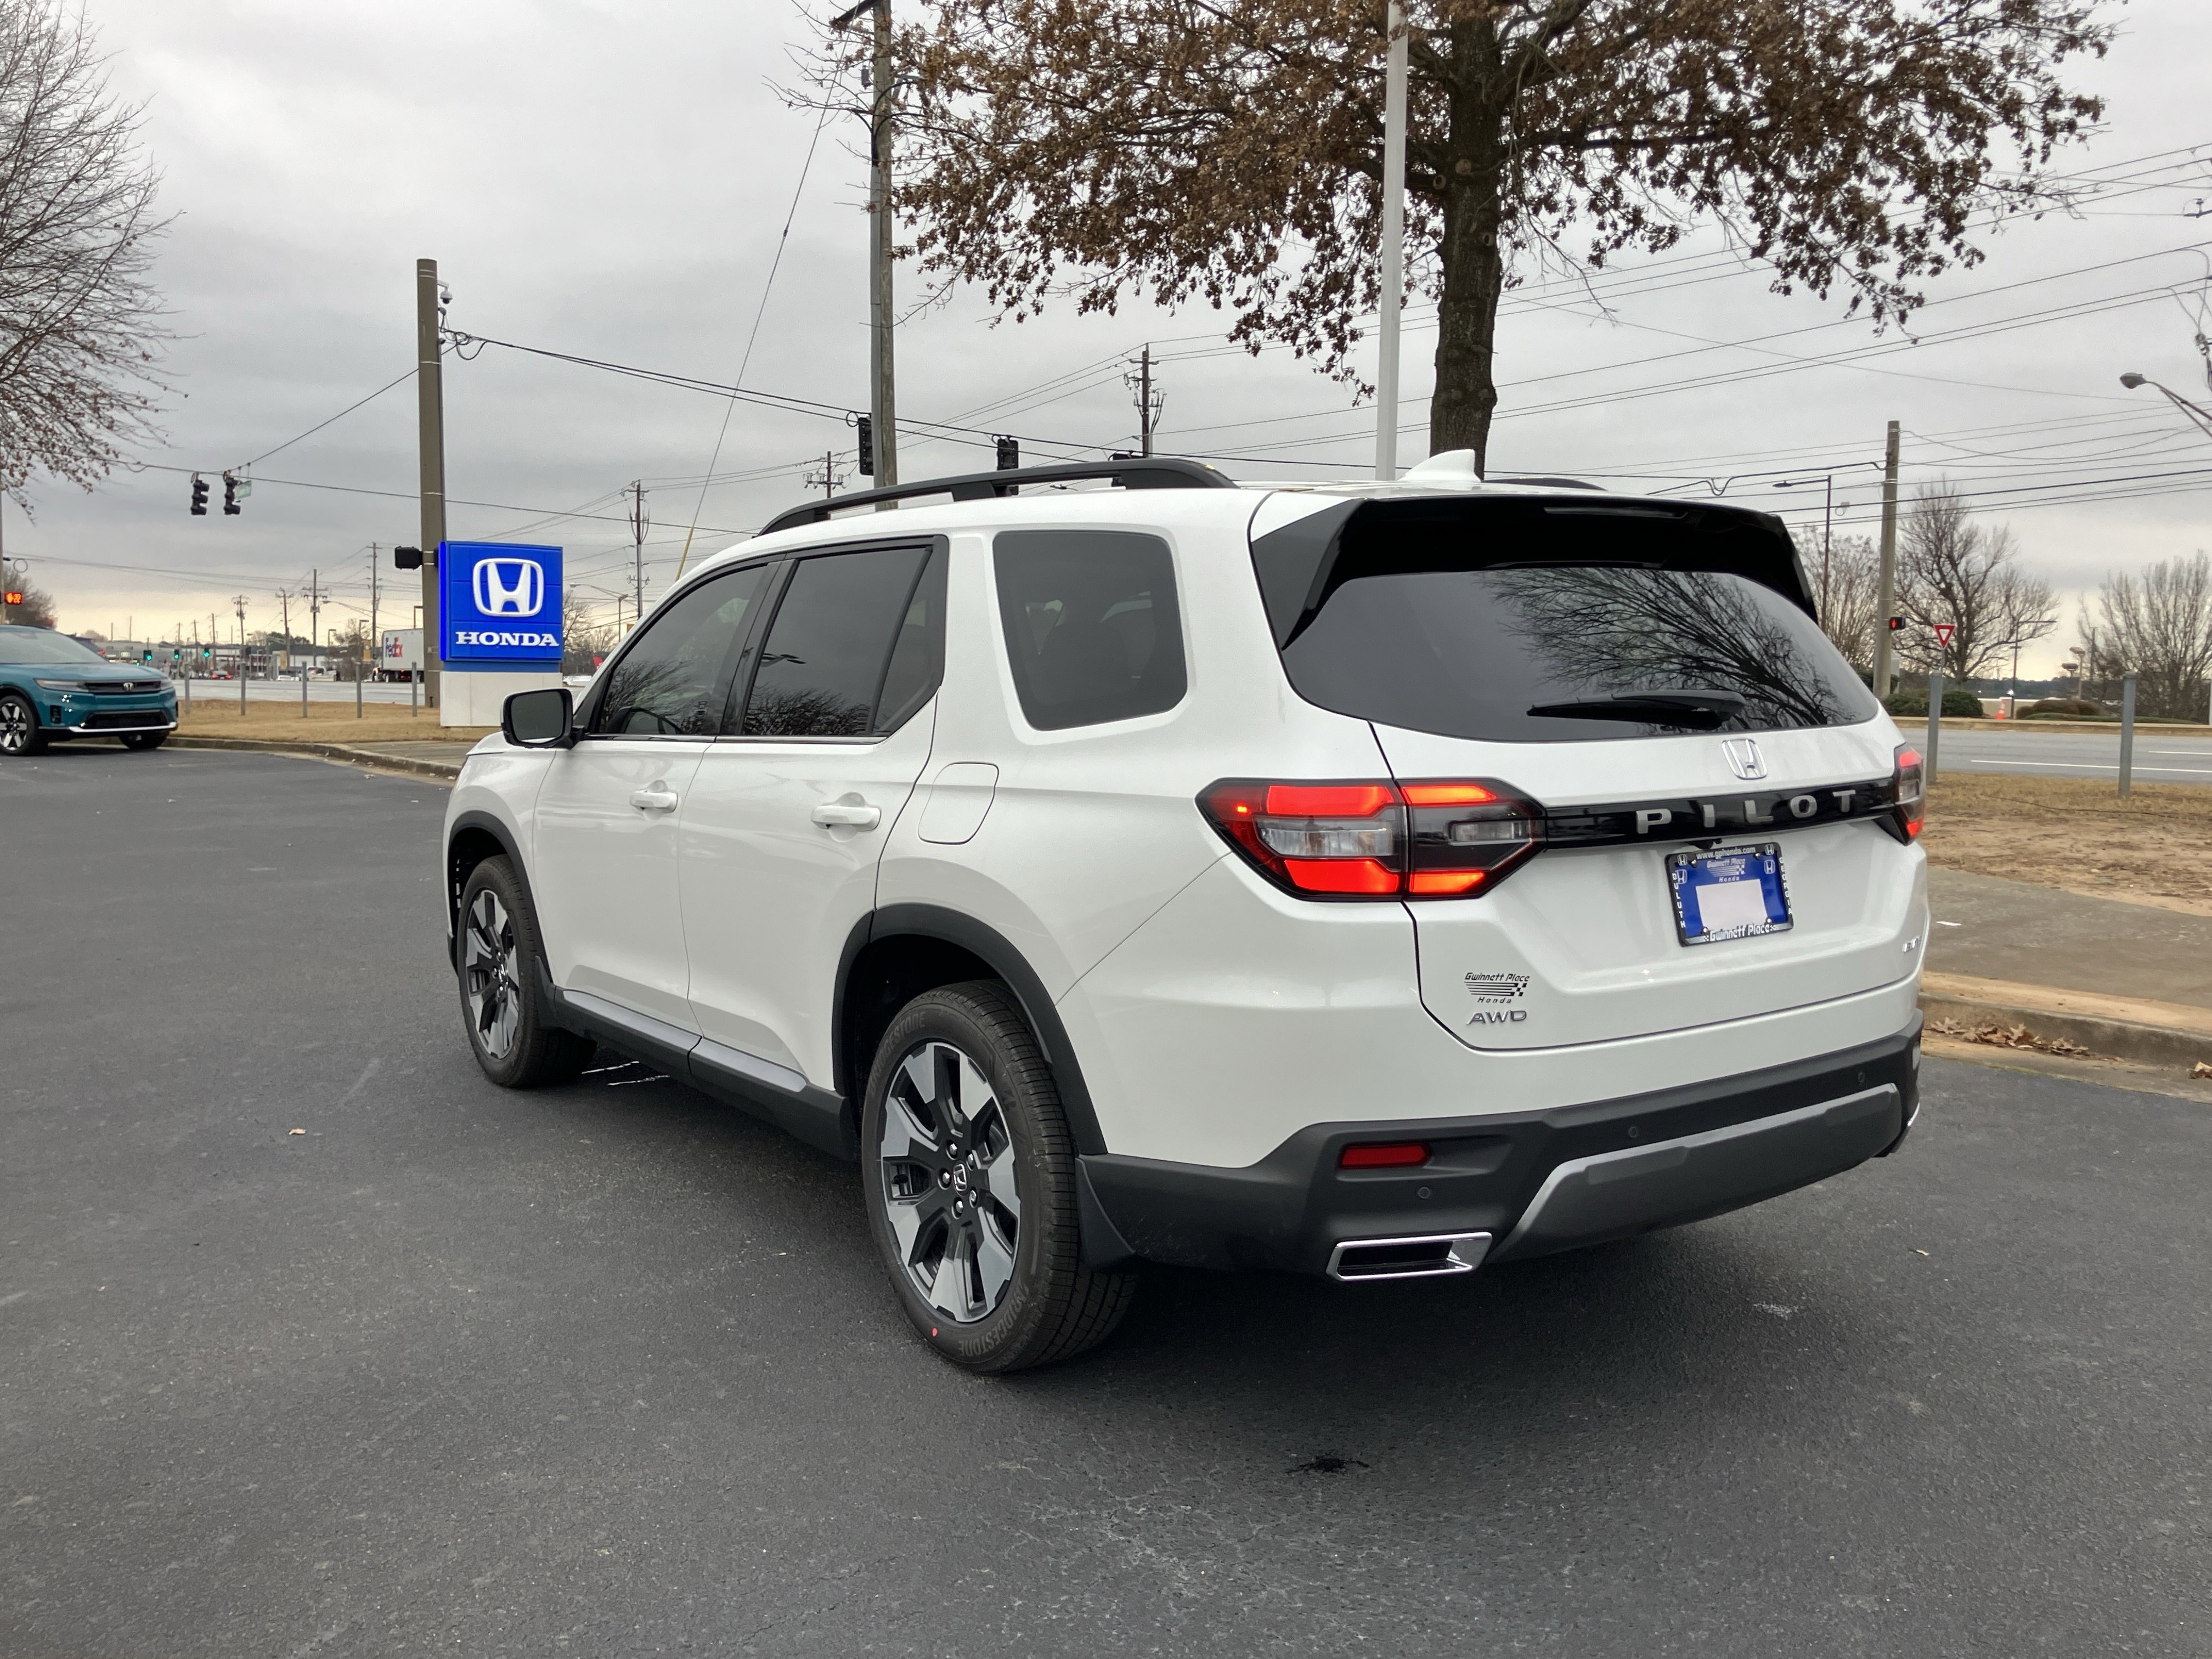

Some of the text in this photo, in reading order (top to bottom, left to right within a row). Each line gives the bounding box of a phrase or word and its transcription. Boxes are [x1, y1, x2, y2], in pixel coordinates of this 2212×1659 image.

[455, 632, 560, 647] HONDA
[1635, 789, 1856, 834] PILOT
[1696, 847, 1756, 860] www.gphonda.com
[1707, 860, 1730, 868] Gwinnett
[1672, 873, 1686, 928] DULUTH
[1709, 923, 1770, 941] Gwinnett Place
[1464, 972, 1530, 982] Gwinnett Place
[1466, 1010, 1527, 1025] AWD
[958, 1283, 1027, 1357] BRIDGESTONE
